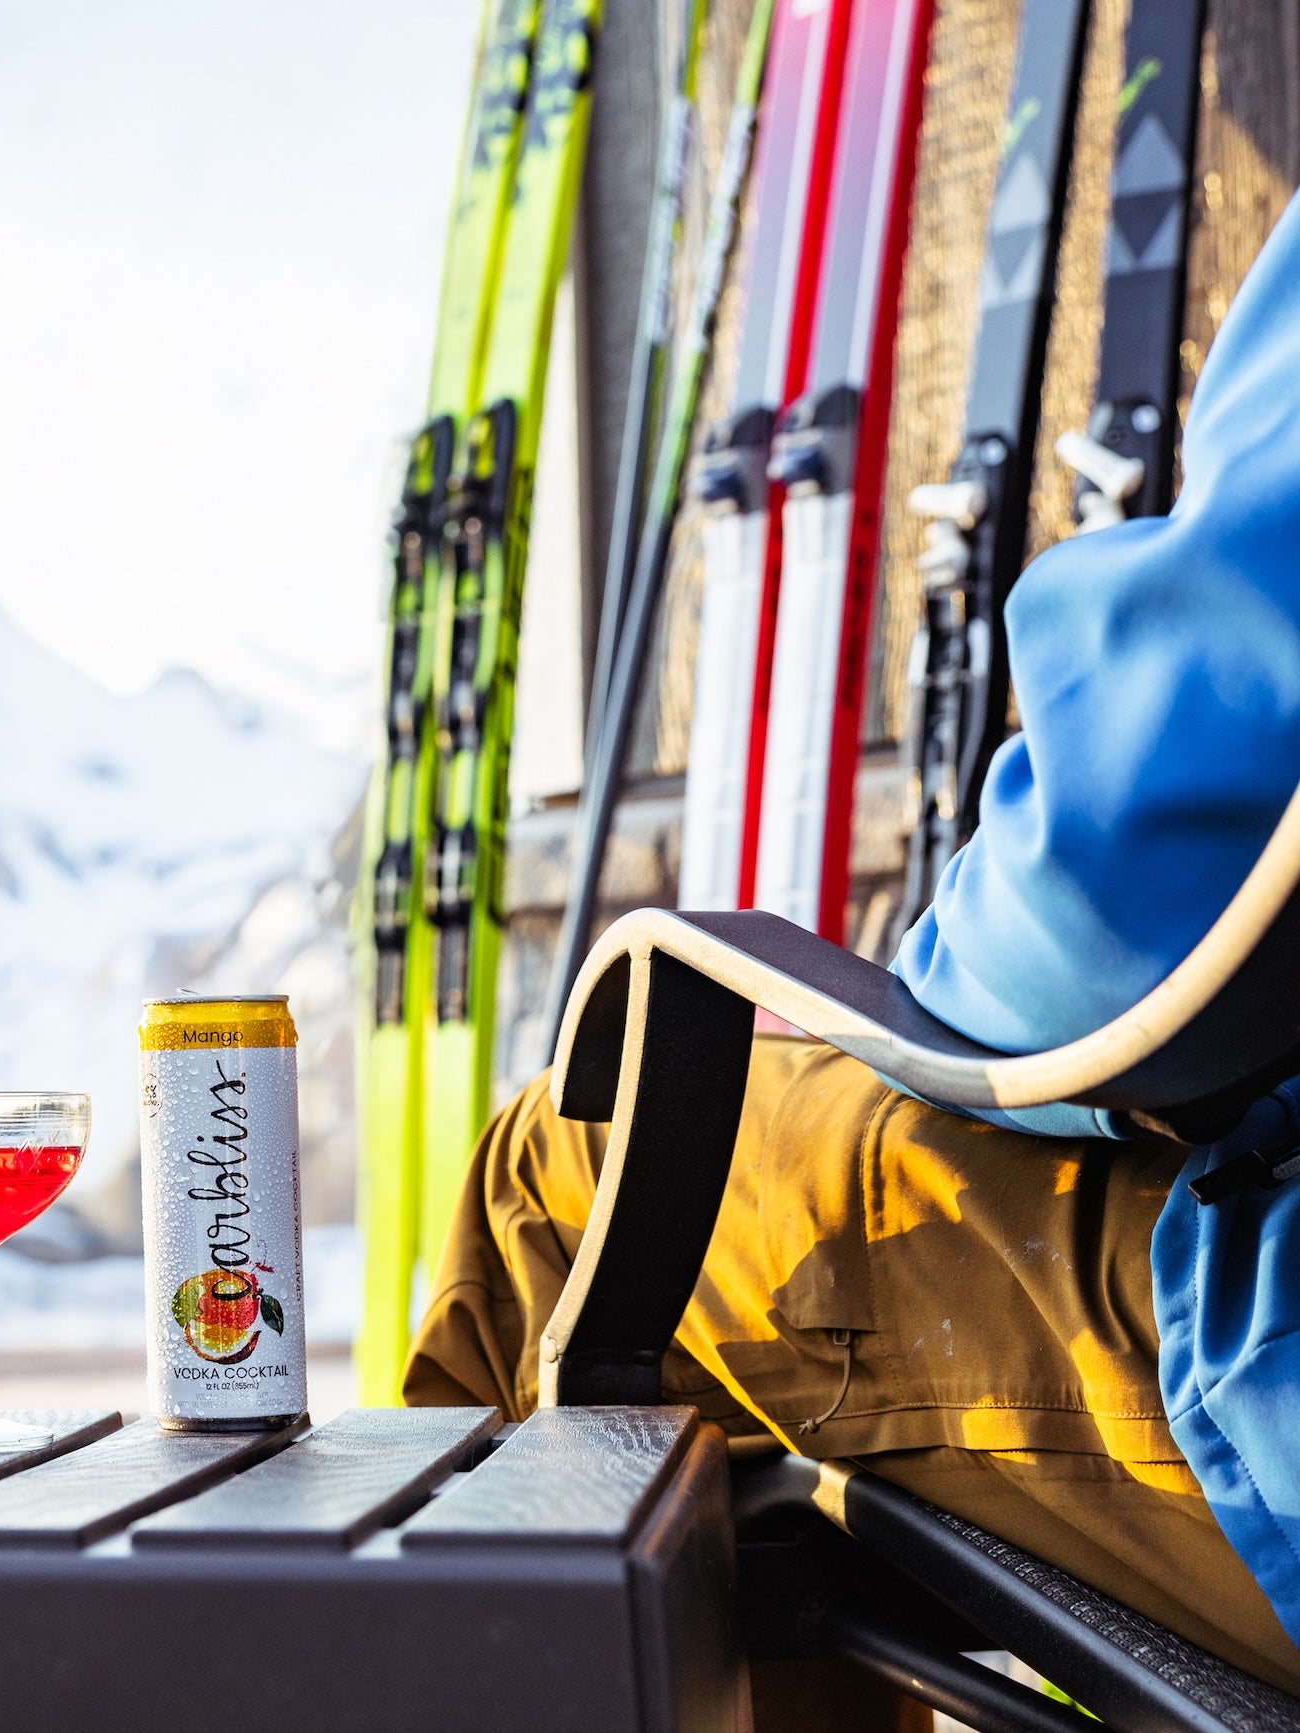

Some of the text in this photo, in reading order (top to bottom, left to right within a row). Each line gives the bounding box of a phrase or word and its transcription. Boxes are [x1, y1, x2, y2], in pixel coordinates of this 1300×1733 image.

[182, 1030, 244, 1046] Mango
[187, 1060, 251, 1301] carbliss
[292, 1215, 301, 1259] VODKA
[173, 1365, 289, 1380] VODKA COCKTAIL
[221, 1382, 231, 1390] OZ
